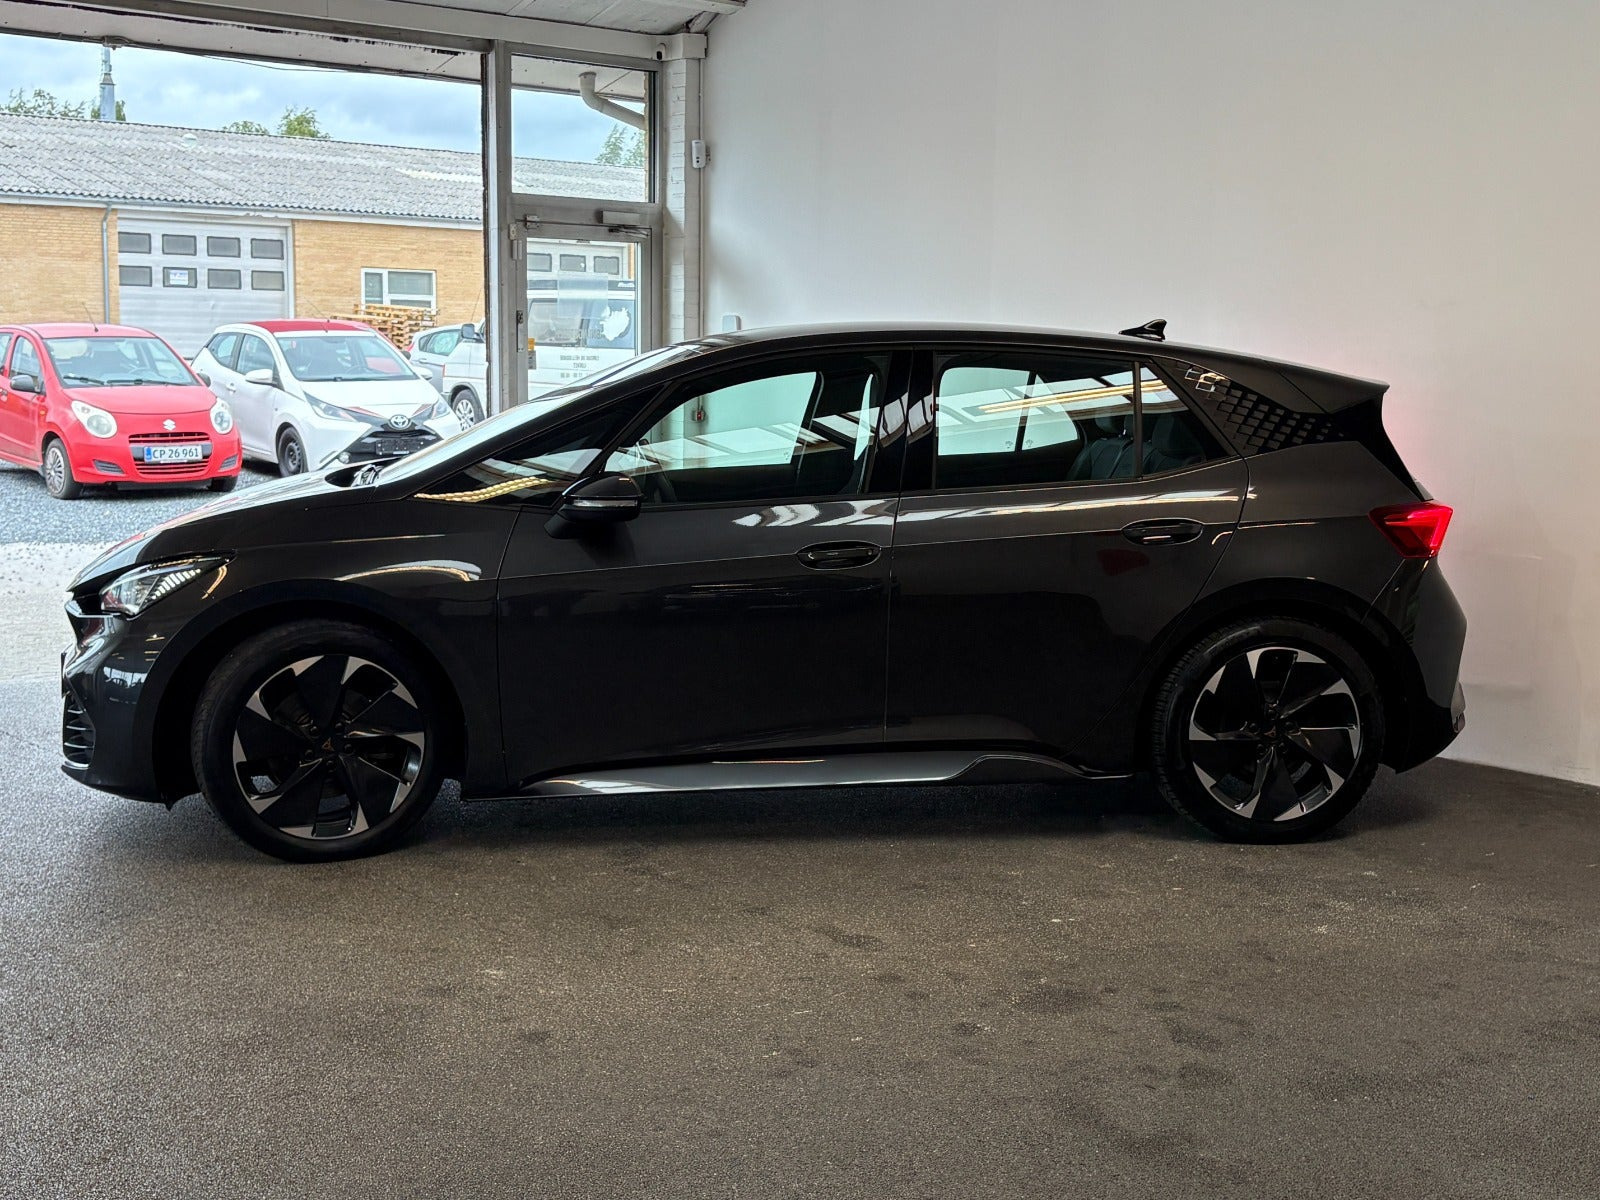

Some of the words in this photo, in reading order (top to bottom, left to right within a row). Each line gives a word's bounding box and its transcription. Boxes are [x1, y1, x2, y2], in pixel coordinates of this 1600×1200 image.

[153, 449, 165, 458] CP
[168, 448, 180, 458] 26
[182, 448, 199, 457] 961
